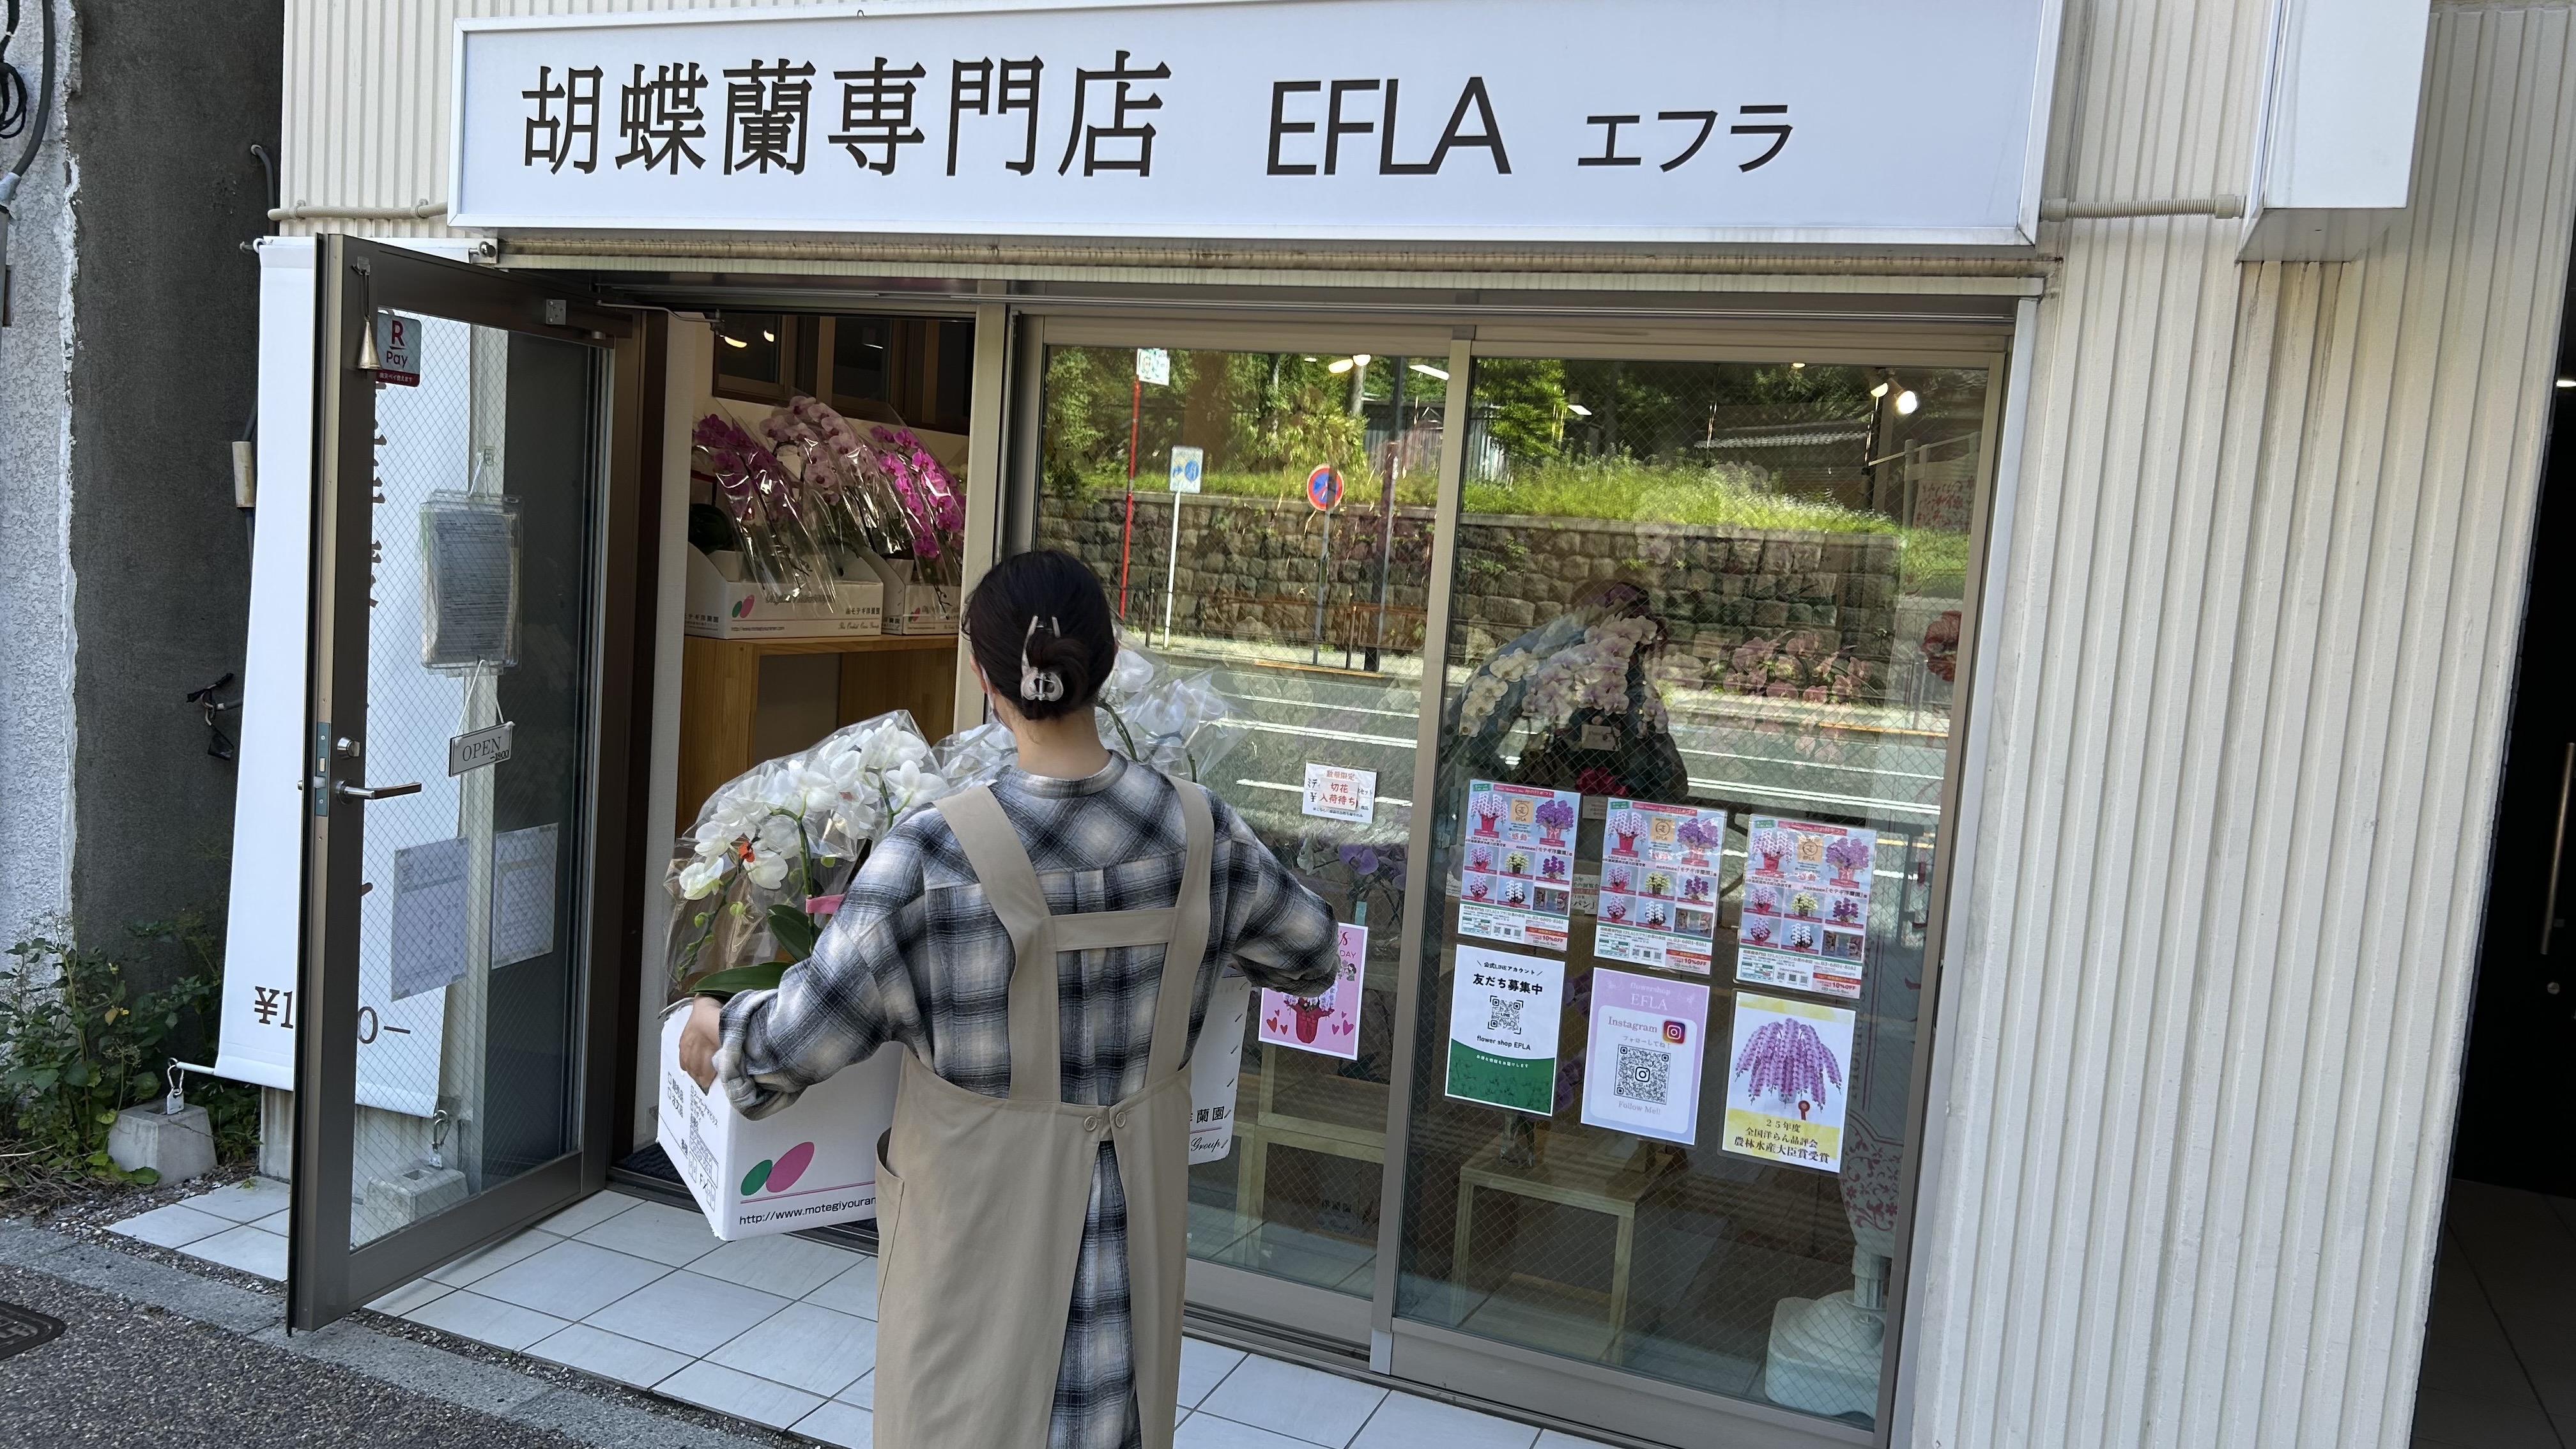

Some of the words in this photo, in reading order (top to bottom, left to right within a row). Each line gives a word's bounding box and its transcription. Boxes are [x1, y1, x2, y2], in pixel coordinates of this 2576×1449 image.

[521, 50, 1171, 178] 胡蝶蘭専門店
[1266, 77, 1511, 176] EFLA
[1578, 105, 1793, 173] エフラ
[392, 320, 404, 346] R
[387, 350, 408, 369] Pay
[463, 736, 502, 762] OPEN
[1331, 783, 1349, 793] 切花
[1319, 793, 1355, 806] 入荷待ち
[1483, 962, 1535, 975] 公式LINEアカウント
[1473, 973, 1543, 995] 友だち募集中
[1630, 982, 1671, 996] flowershop
[1832, 982, 1856, 990] 10%OFF
[1630, 993, 1668, 1011] EFLA
[1608, 1016, 1657, 1033] Instagram
[1476, 1034, 1496, 1044] flower
[1497, 1039, 1512, 1047] shop
[1514, 1041, 1531, 1050] EFLA
[1190, 1106, 1225, 1124] 蘭園
[1618, 1101, 1643, 1112] Follow
[1190, 1137, 1220, 1153] Group
[1745, 1126, 1818, 1149] 全国洋らん品評会
[1734, 1136, 1830, 1164] 農林水産大臣賞受賞
[740, 1197, 877, 1225] http://www.motegiyouran
